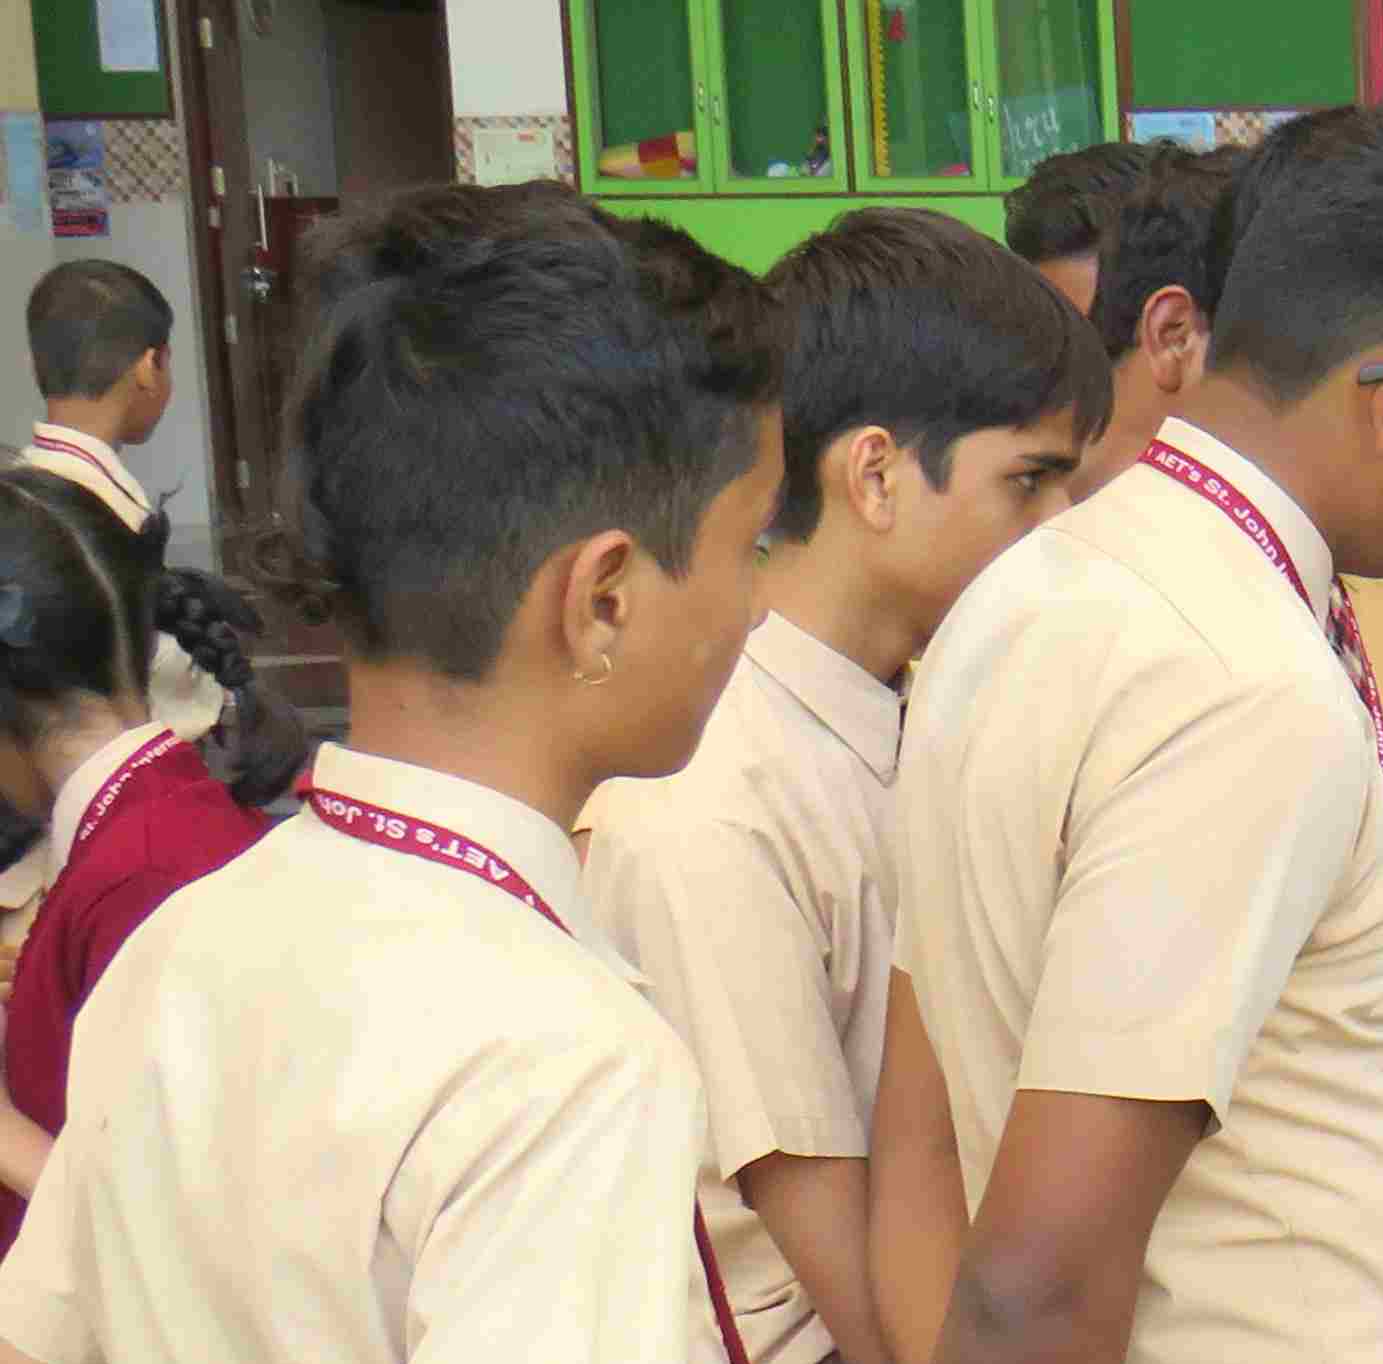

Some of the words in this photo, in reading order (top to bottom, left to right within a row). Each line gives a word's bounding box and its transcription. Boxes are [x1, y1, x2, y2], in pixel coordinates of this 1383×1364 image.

[1155, 450, 1201, 483] AET's
[1203, 477, 1231, 506] St.
[1233, 506, 1279, 568] John
[95, 771, 132, 816] John
[368, 812, 409, 840] St.
[415, 827, 510, 882] AET's
